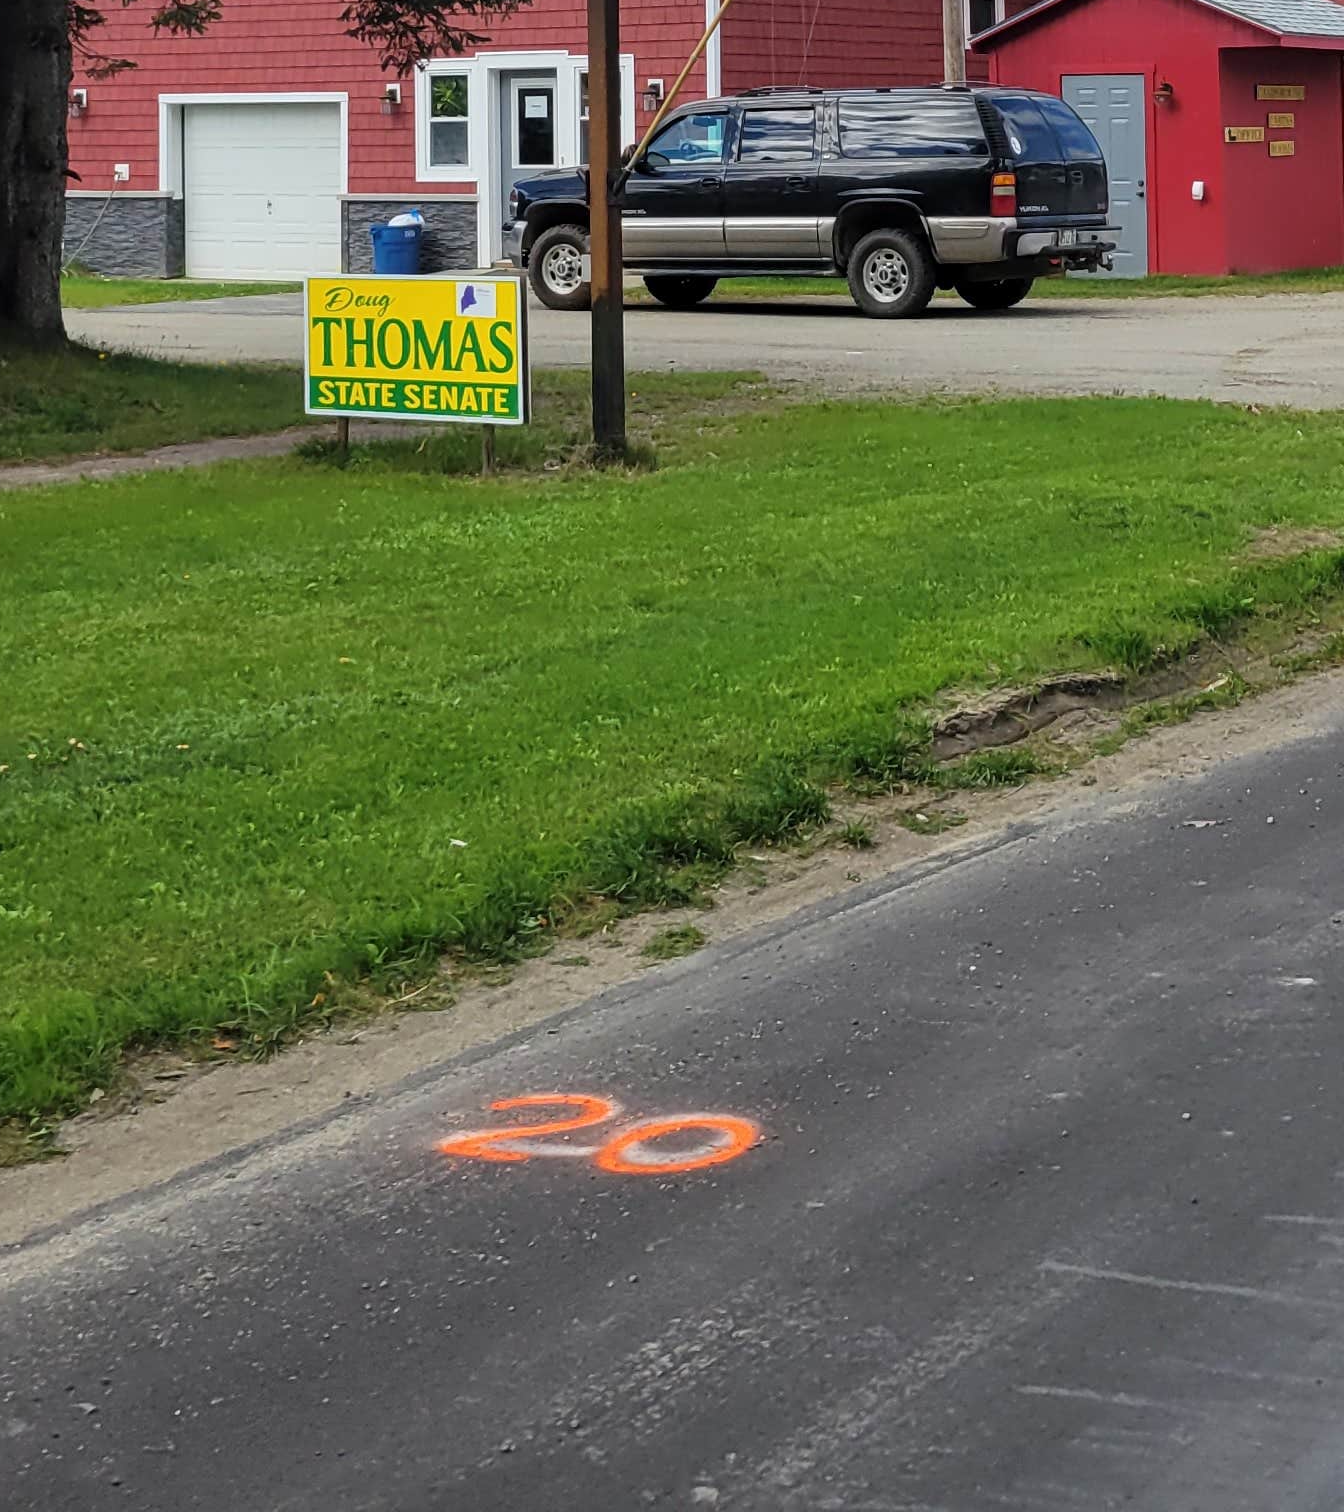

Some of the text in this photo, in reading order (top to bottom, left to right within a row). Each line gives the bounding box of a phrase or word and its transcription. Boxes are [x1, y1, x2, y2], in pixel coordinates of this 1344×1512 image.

[325, 287, 394, 317] Doug
[312, 317, 514, 373] THOMAS
[318, 380, 510, 413] STATE SENATE
[437, 1094, 757, 1174] 20
